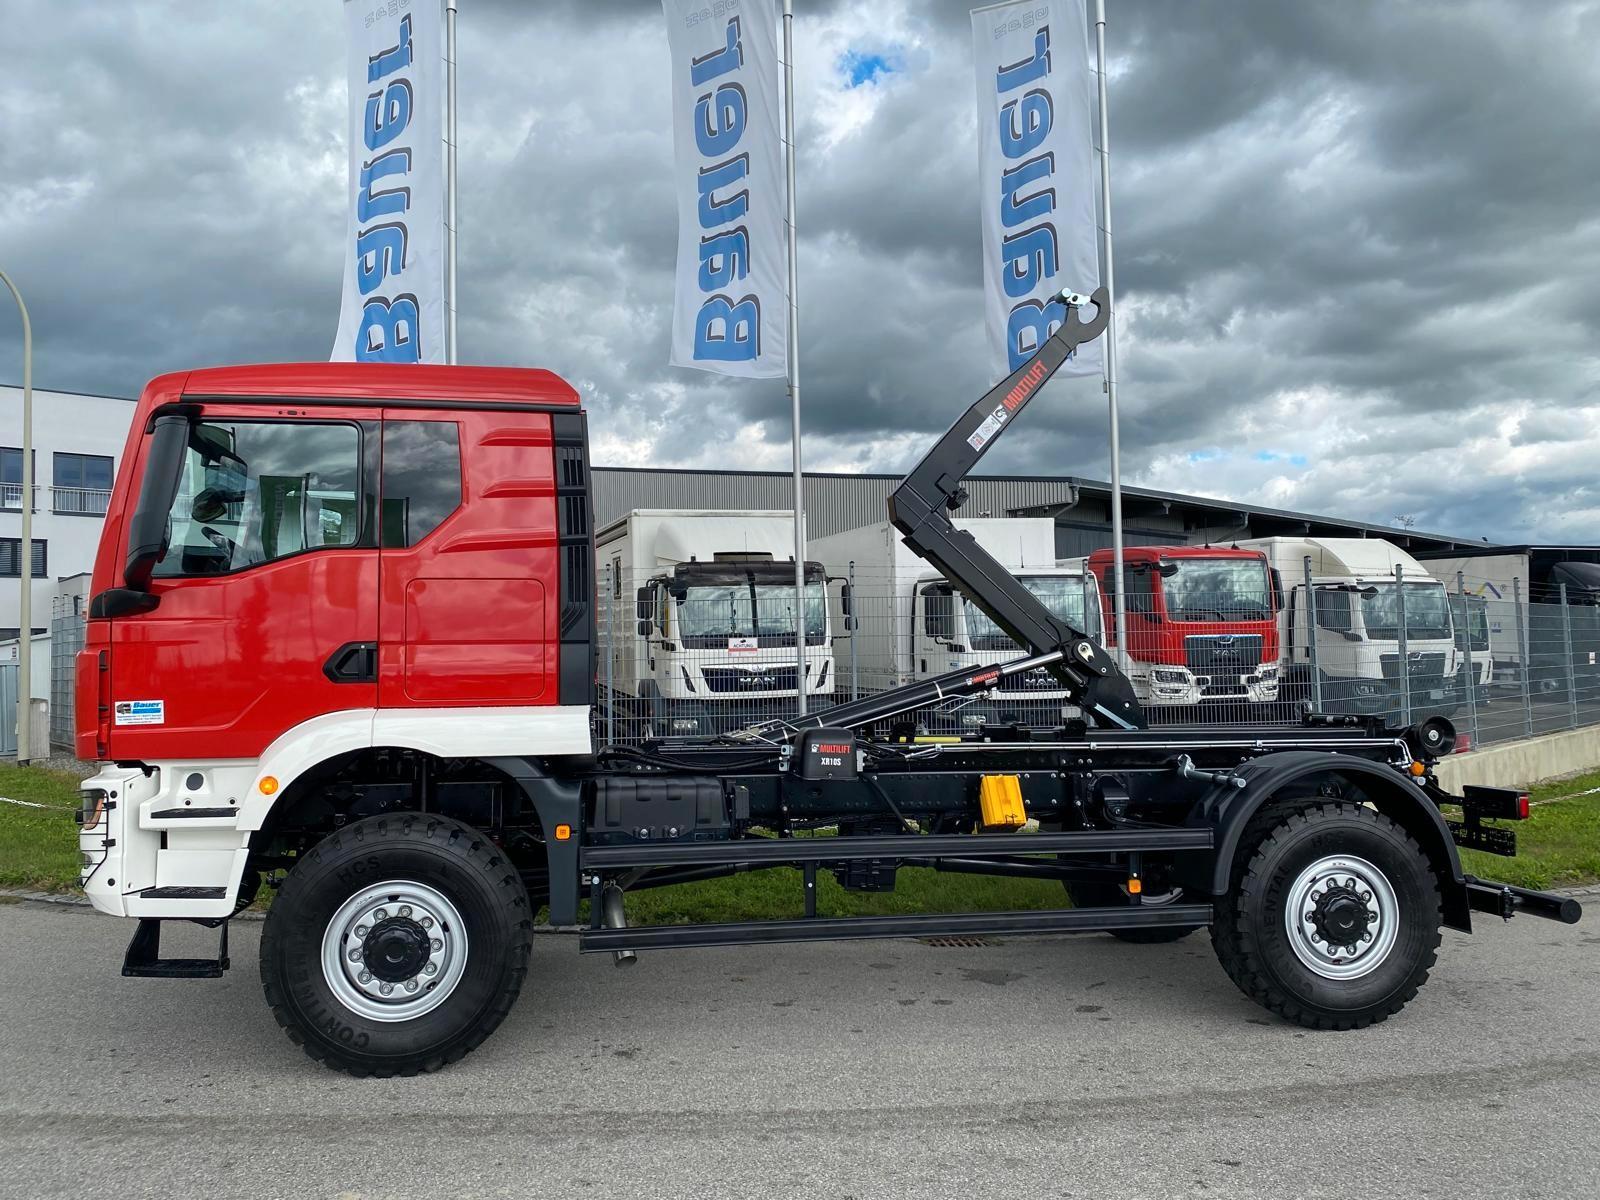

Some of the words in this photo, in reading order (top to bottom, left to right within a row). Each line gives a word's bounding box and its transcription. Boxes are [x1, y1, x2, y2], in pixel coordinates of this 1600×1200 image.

[1003, 359, 1048, 411] MULTILIFT
[739, 676, 776, 686] MAN
[1025, 677, 1058, 686] MAN
[819, 744, 851, 754] MULTILIFT
[821, 757, 842, 766] XR10S
[336, 854, 382, 885] HCS
